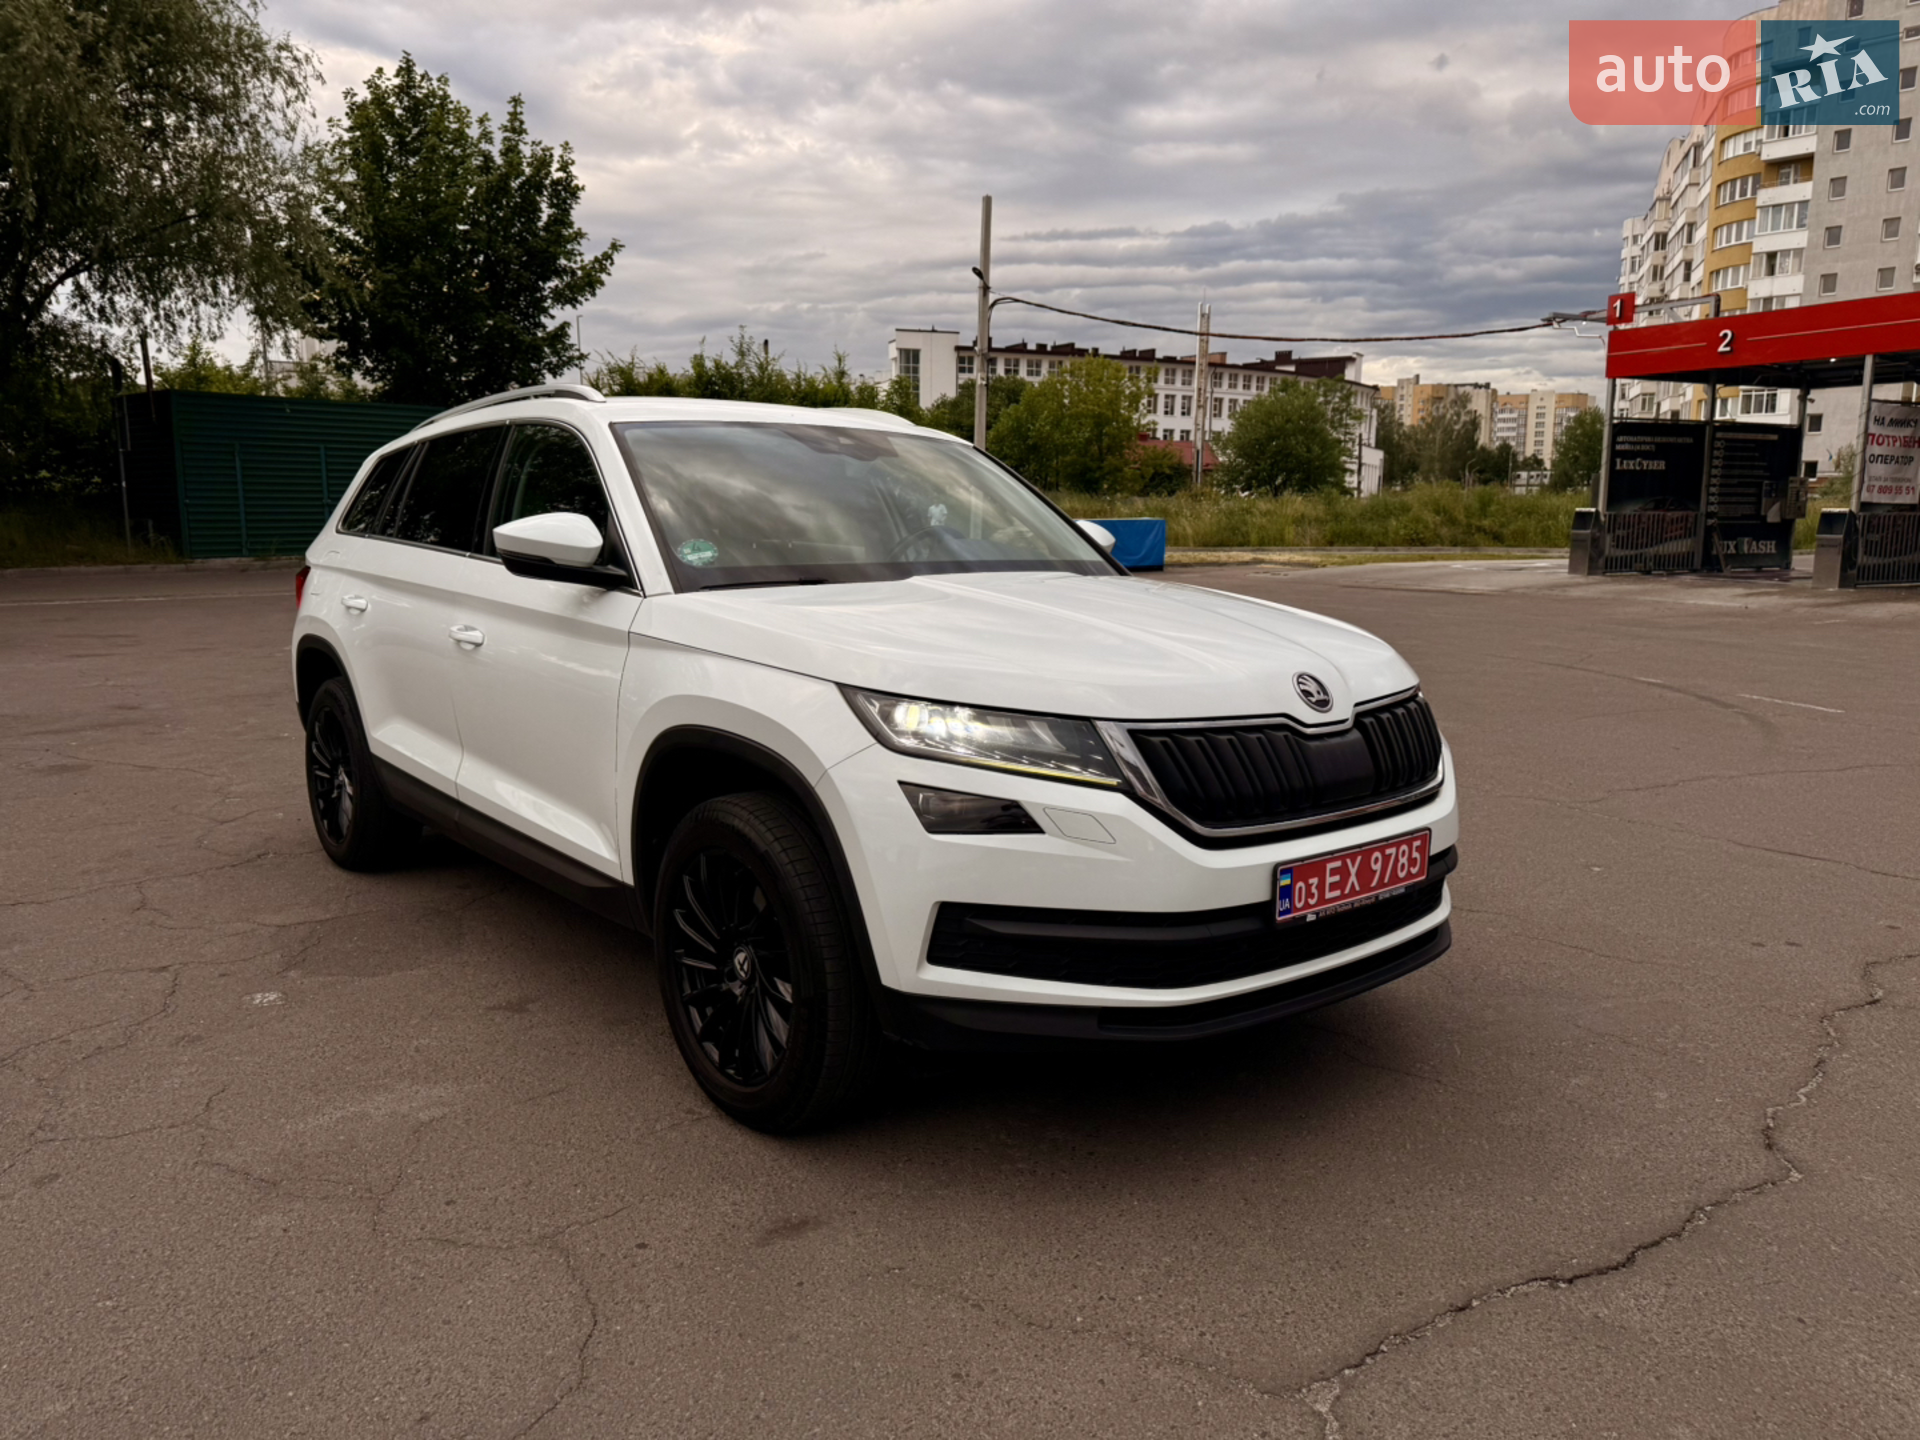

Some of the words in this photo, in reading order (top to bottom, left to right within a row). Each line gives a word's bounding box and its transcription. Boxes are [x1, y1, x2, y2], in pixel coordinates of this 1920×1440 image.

[1612, 299, 1623, 319] 1
[1716, 329, 1735, 353] 2
[1873, 415, 1885, 427] НА
[1868, 453, 1914, 466] ОПЕРАТОР
[1877, 484, 1893, 495] 809
[1294, 876, 1319, 909] 03
[1325, 855, 1362, 900] EX
[1370, 839, 1422, 888] 9785
[1279, 898, 1291, 912] UA
